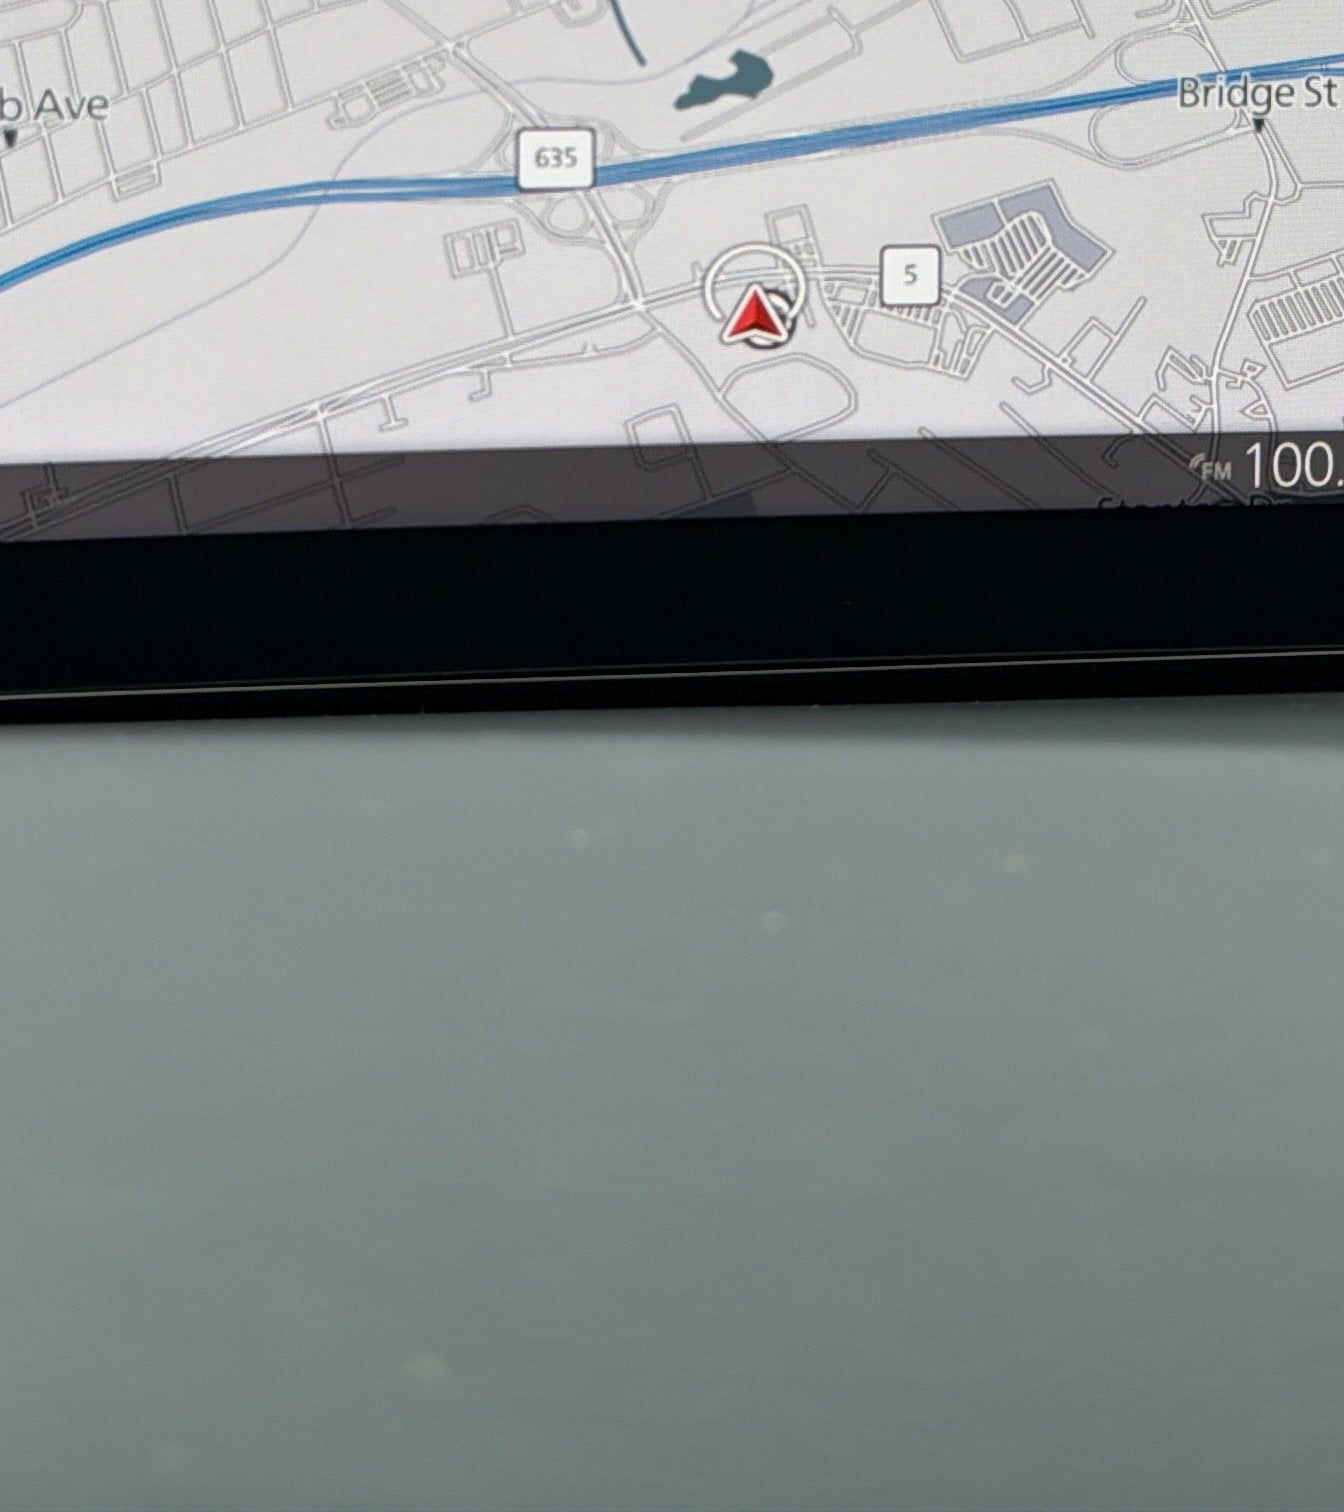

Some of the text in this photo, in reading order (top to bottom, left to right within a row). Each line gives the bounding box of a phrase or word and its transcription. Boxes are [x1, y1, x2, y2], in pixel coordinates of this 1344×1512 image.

[34, 94, 110, 120] Ave
[1178, 75, 1338, 116] Bridge St
[534, 146, 578, 169] 635
[903, 263, 919, 287] 5
[1201, 459, 1233, 481] FM
